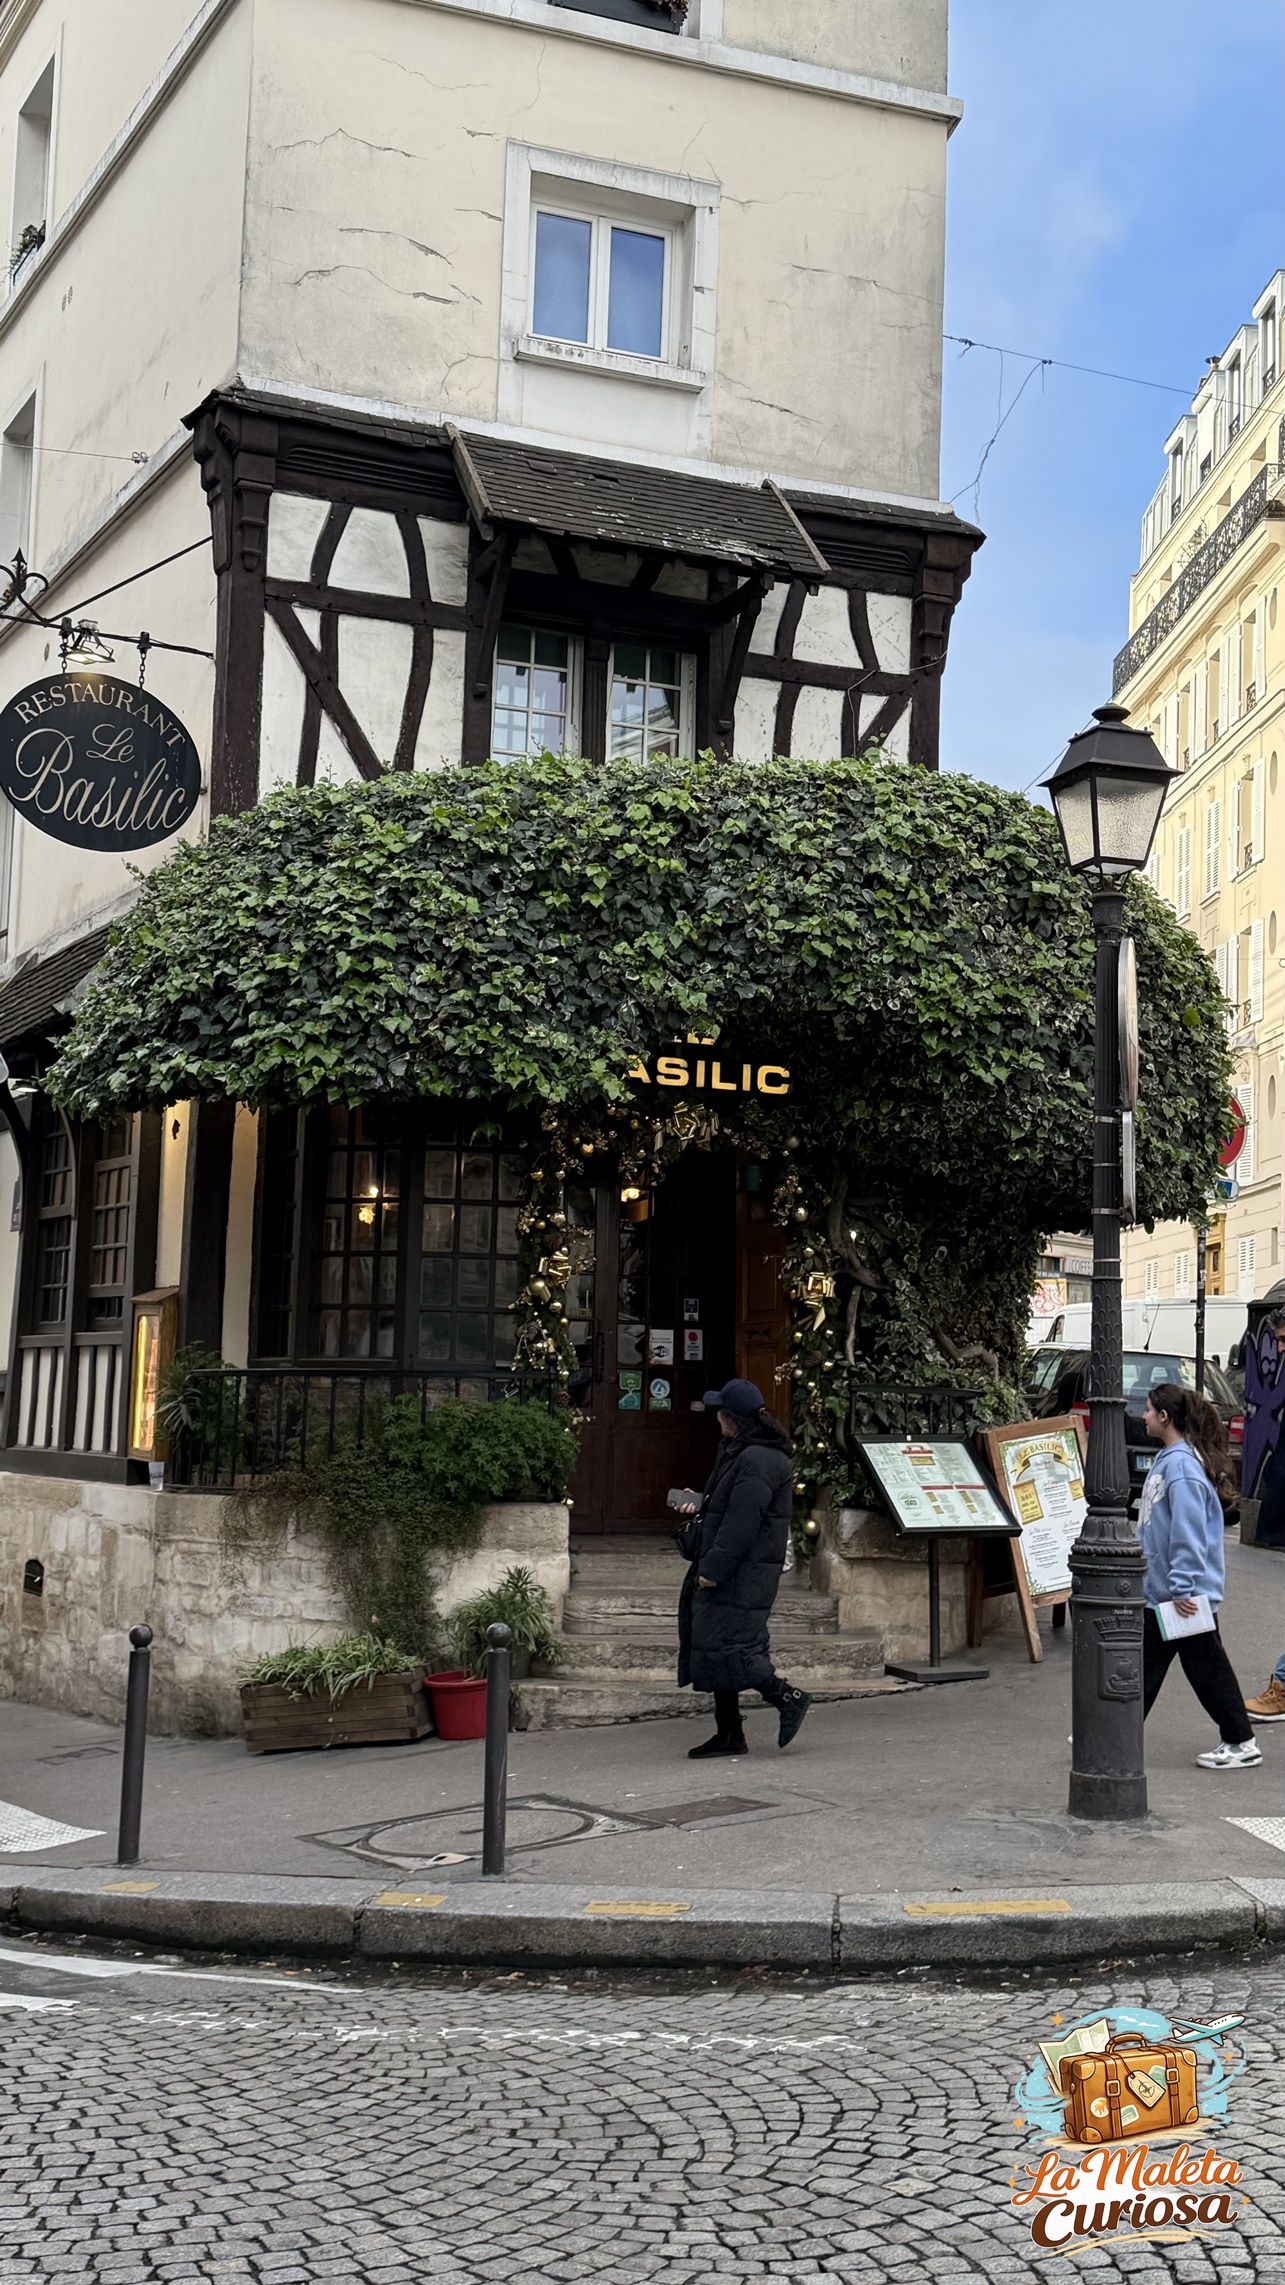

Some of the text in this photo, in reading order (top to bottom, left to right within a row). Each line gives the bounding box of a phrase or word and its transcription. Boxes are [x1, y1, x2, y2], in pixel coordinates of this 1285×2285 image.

[14, 682, 186, 748] RESTAURANT
[85, 723, 135, 764] Le
[8, 728, 188, 831] Basilic
[621, 1054, 791, 1095] ASILIC
[1018, 1441, 1061, 1458] LE BASILIC
